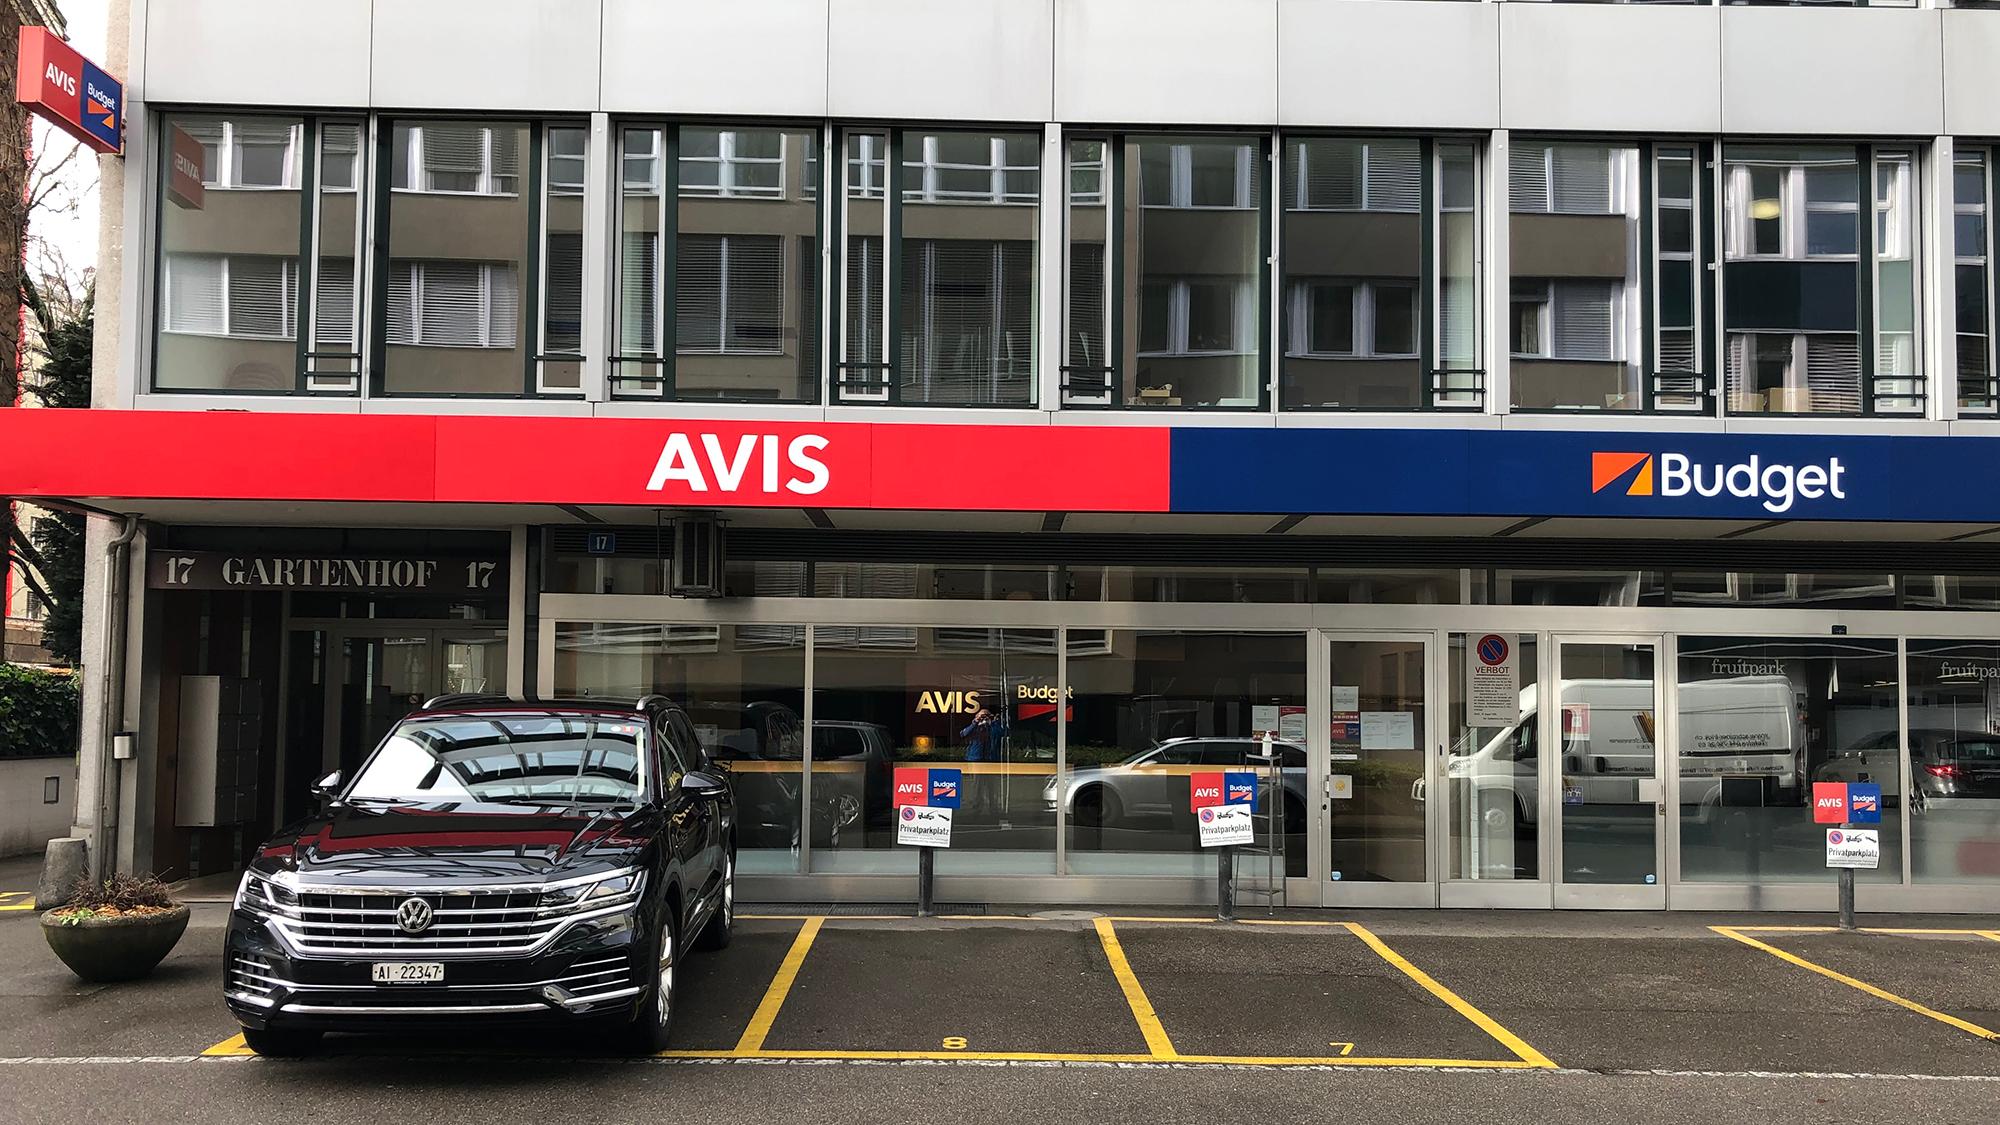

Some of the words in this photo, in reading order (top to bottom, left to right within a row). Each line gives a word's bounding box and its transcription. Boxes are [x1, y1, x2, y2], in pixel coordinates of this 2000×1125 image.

[45, 62, 76, 97] AVIS
[87, 82, 115, 110] Budget
[645, 432, 830, 495] AVIS
[1661, 452, 1845, 513] Budget
[596, 536, 608, 550] 17
[165, 557, 196, 585] 17
[222, 558, 438, 587] GARTENHOF
[466, 560, 497, 589] 17
[1711, 658, 1786, 676] fruitpark
[1941, 661, 2000, 681] fruitpa
[1017, 684, 1074, 703] Budgt
[915, 690, 981, 714] AVIS
[898, 783, 923, 793] AVIS
[933, 780, 956, 790] Budget
[1229, 784, 1253, 793] Budget
[1195, 788, 1219, 797] AVIS
[1852, 794, 1876, 803] Budget
[1818, 798, 1842, 808] AVIS
[900, 823, 949, 836] Privatparkplatz
[1201, 823, 1251, 835] Privatparkplatz
[1828, 847, 1878, 858] Privatparkplatz
[378, 965, 390, 979] AI
[400, 965, 440, 979] 22347
[942, 1036, 968, 1049] 8
[1329, 1042, 1354, 1055] 7
